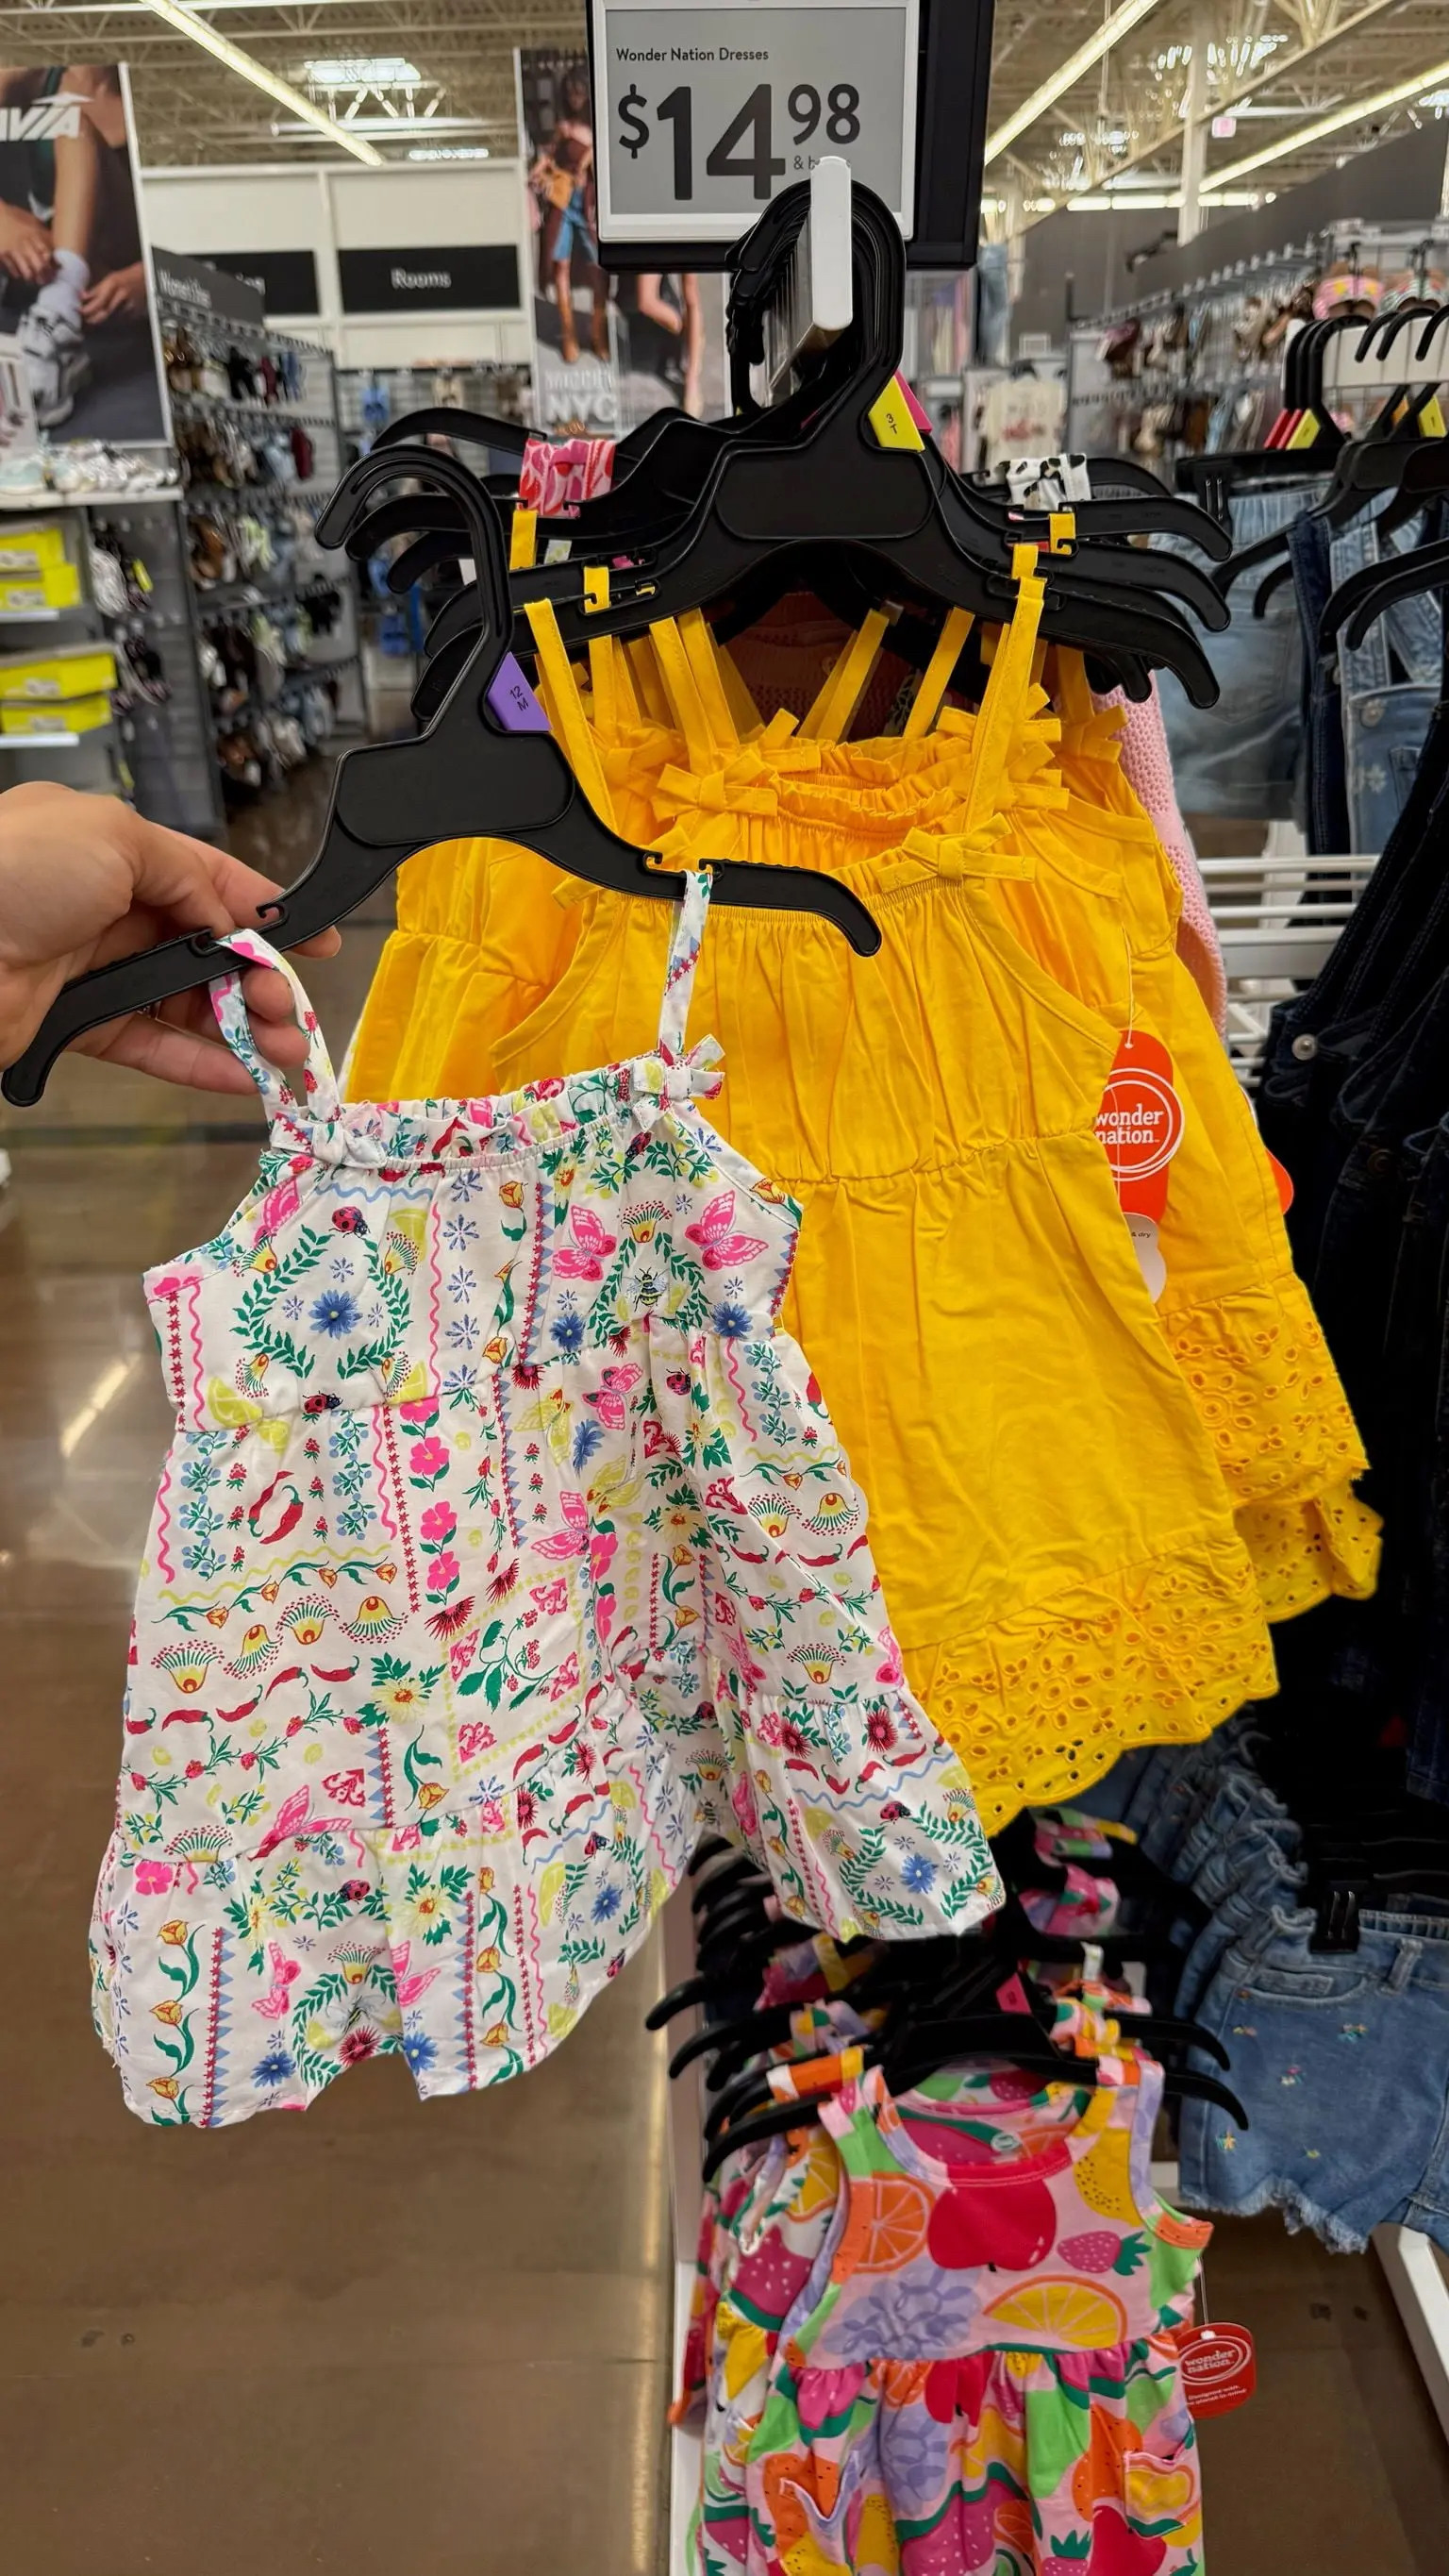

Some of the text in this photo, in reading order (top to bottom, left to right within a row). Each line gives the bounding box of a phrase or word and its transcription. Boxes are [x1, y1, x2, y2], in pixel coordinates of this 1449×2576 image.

[616, 47, 769, 61] Wonder Nation Dresses
[0, 105, 81, 142] VIA
[391, 268, 452, 290] Rooms
[546, 393, 618, 423] NYC
[509, 685, 524, 699] 12
[516, 696, 529, 711] M
[1095, 1102, 1164, 1127] wonder
[1094, 1126, 1155, 1145] nation
[1185, 2350, 1236, 2366] wonder
